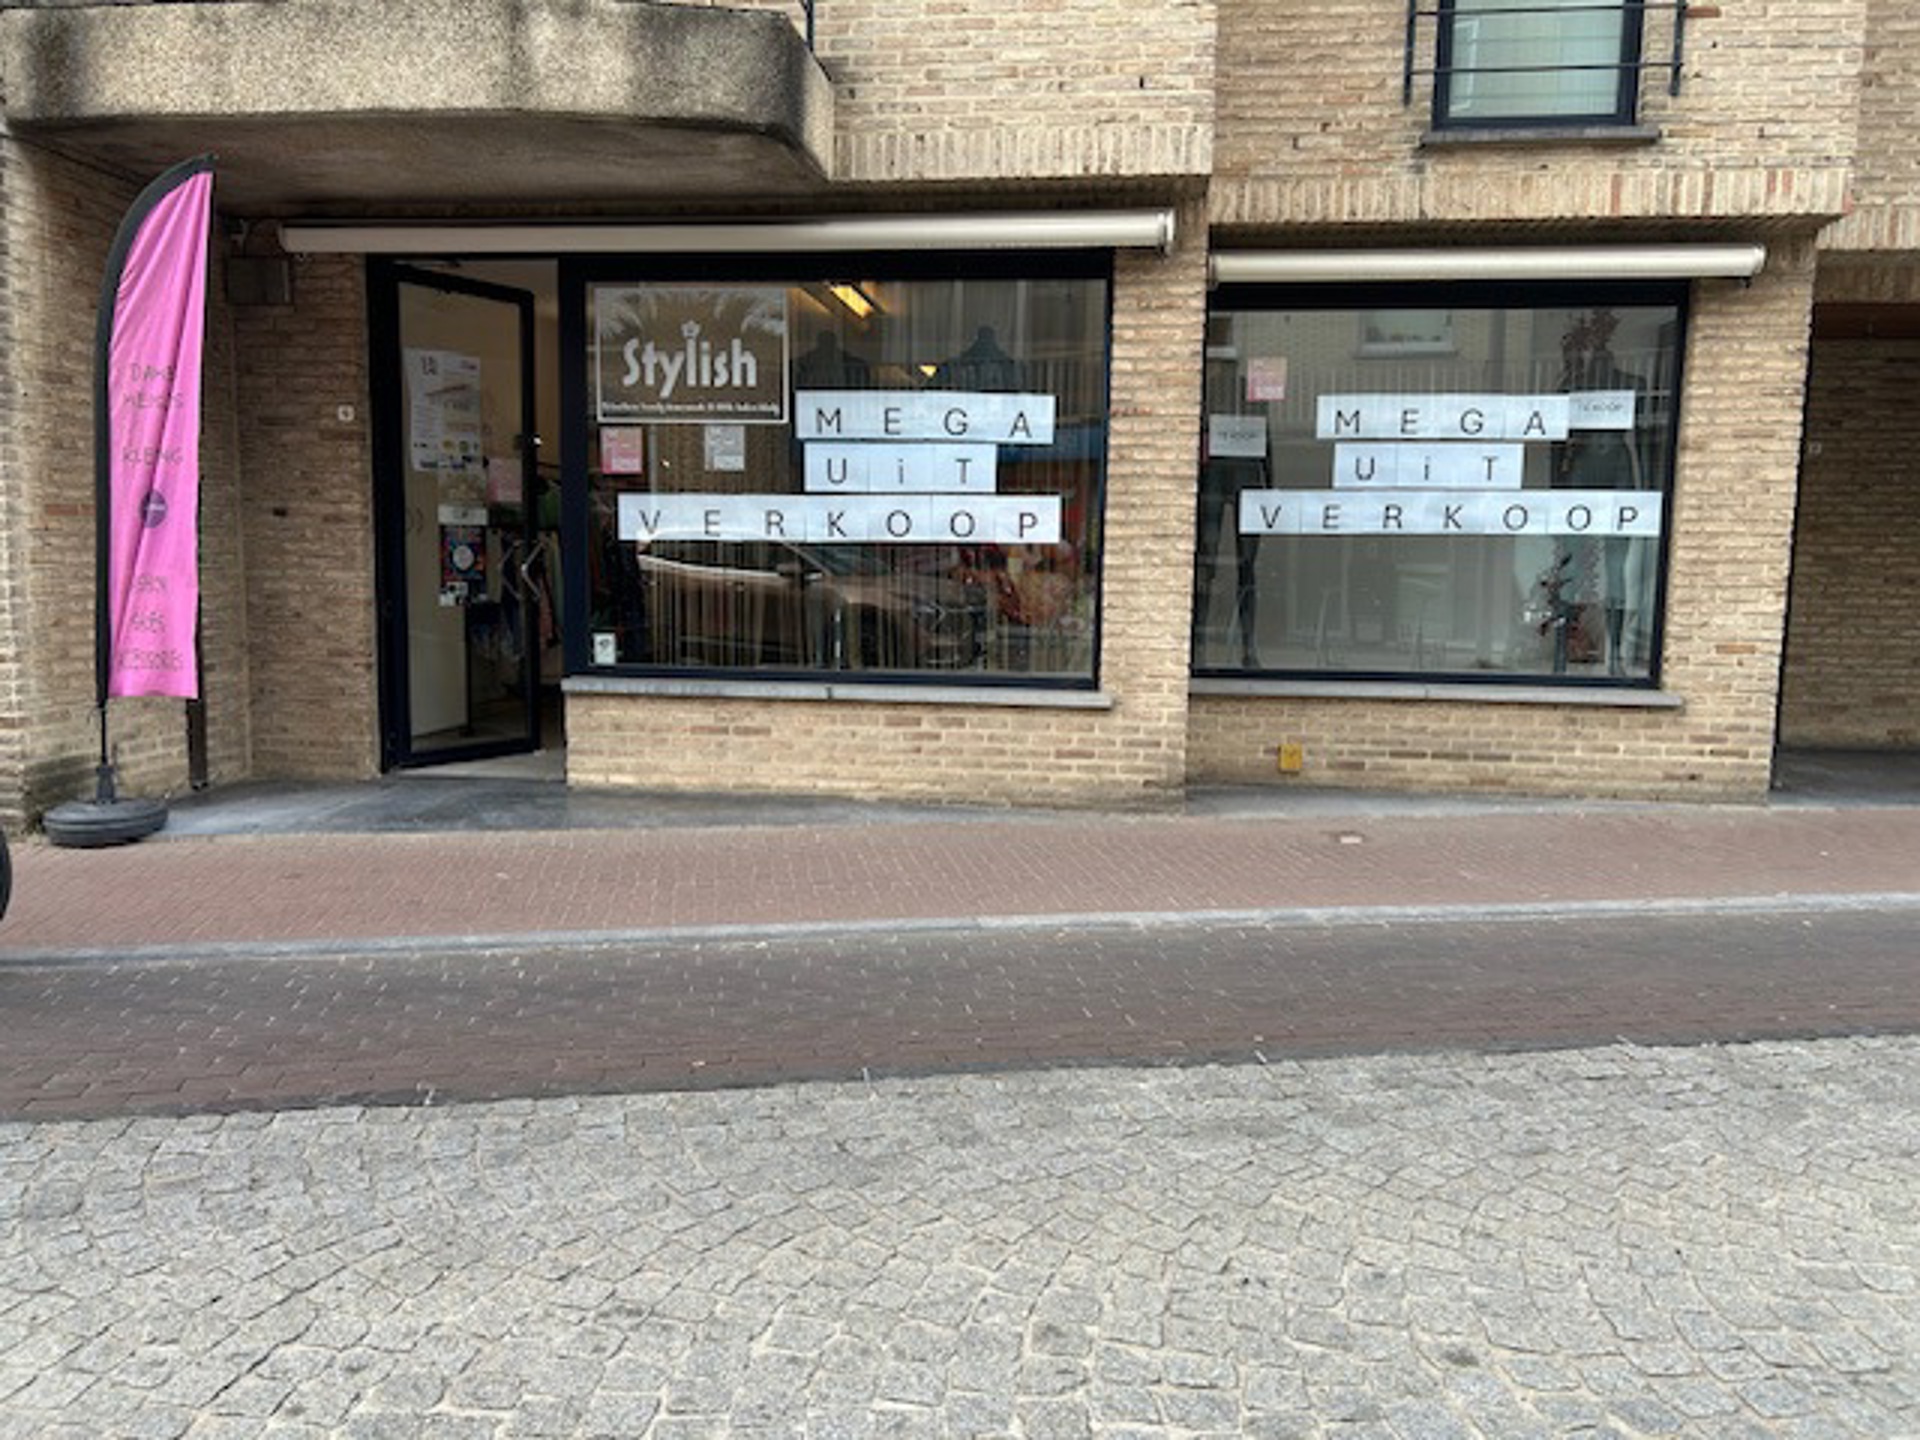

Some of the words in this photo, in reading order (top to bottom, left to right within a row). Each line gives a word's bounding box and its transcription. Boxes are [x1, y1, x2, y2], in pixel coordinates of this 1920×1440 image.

[622, 336, 758, 398] Stylish
[815, 408, 1033, 439] MEGA
[1333, 408, 1547, 436] MEGA
[826, 457, 974, 485] UiT
[1354, 455, 1500, 482] UiT
[639, 509, 1039, 539] VERKOOP
[1259, 504, 1640, 531] VERKOOP
